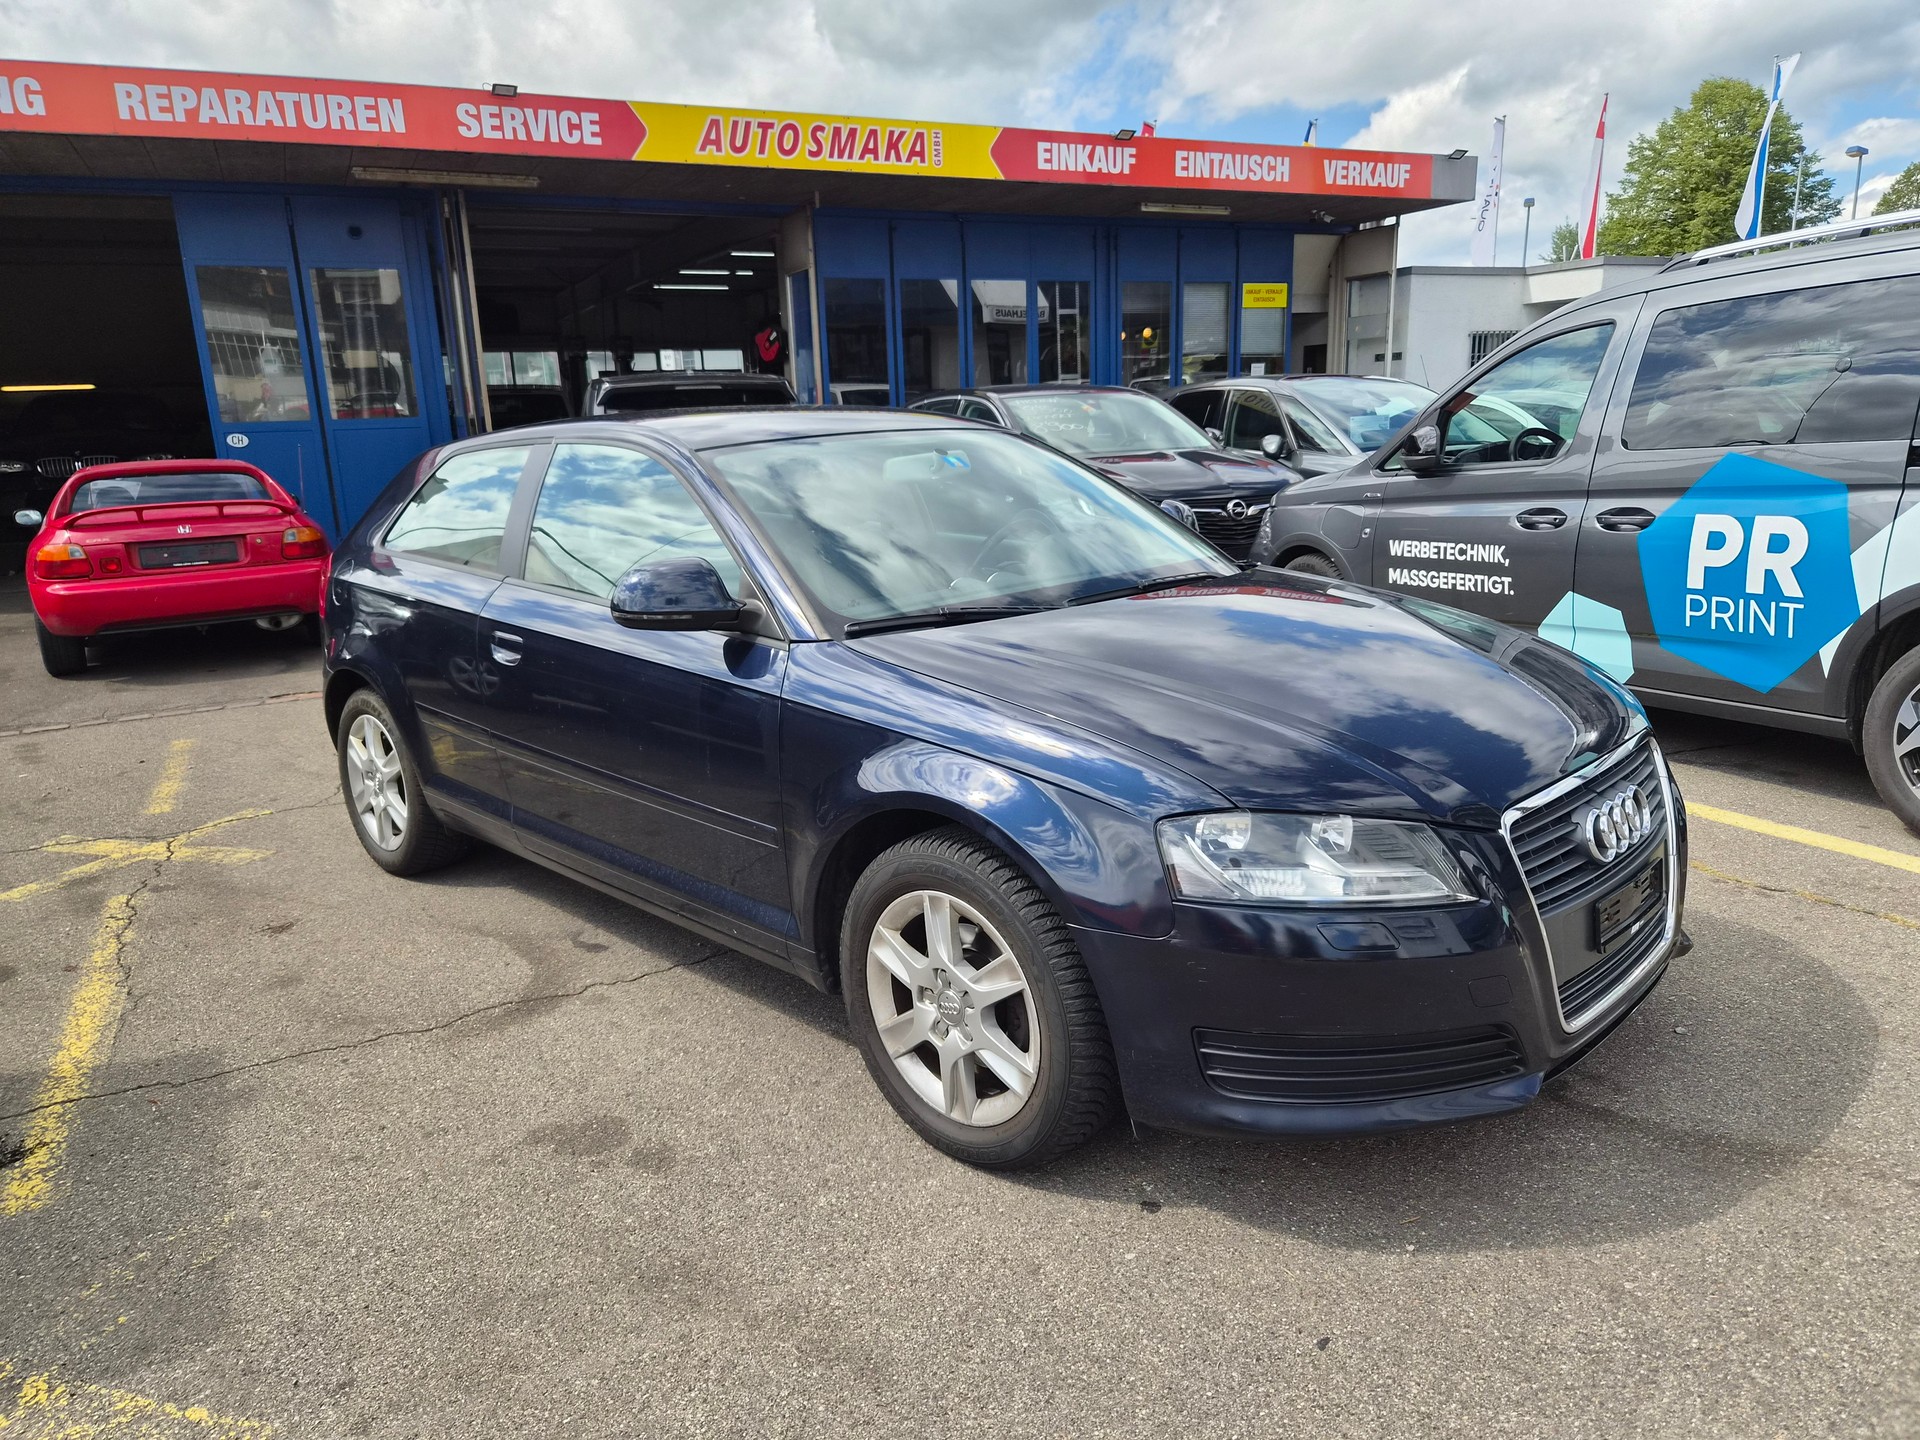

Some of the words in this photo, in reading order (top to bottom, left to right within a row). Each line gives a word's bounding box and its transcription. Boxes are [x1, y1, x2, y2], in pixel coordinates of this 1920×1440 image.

[113, 82, 406, 133] REPARATUREN
[456, 103, 603, 146] SERVICE
[698, 117, 801, 157] AUTO
[807, 125, 926, 164] SMAKA
[933, 131, 942, 167] GMBH
[1037, 141, 1136, 174] EINKAUF
[1175, 150, 1290, 182] EINTAUSCH
[1324, 159, 1411, 188] VERKAUF
[231, 435, 244, 445] CH
[1389, 540, 1509, 567] WERBETECHNIK,
[1686, 513, 1809, 598] PR
[1388, 567, 1515, 595] MASSGEFERTIGT.
[1685, 594, 1805, 639] PRINT
